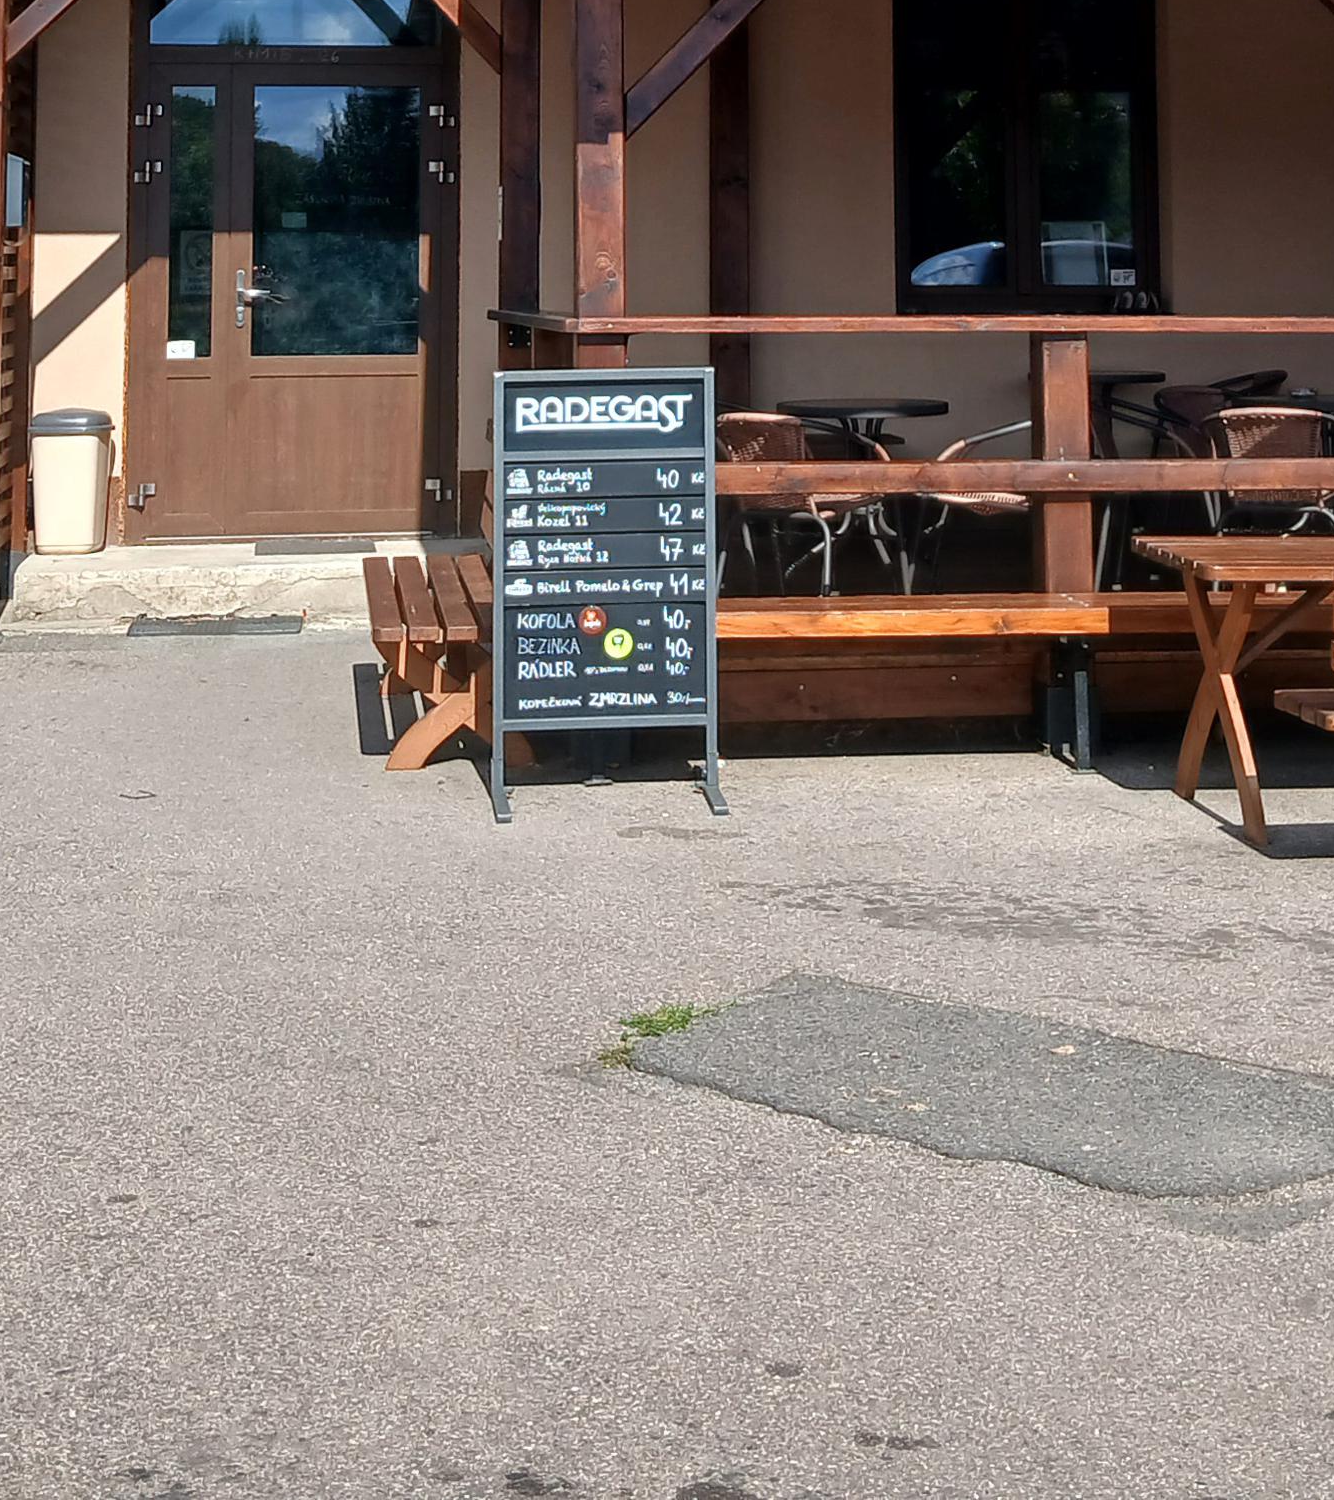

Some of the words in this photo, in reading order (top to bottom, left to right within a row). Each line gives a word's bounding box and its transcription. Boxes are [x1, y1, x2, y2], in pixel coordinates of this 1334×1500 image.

[515, 393, 693, 432] RADEGAST
[537, 467, 593, 485] Radegast
[656, 467, 680, 488] 40
[691, 471, 705, 483] Kč
[576, 481, 591, 492] 10
[537, 514, 571, 528] Kozel
[575, 515, 589, 527] 11
[658, 502, 683, 526] 42
[691, 507, 705, 520] Kč
[537, 537, 594, 556] Radegast
[659, 536, 685, 561] 47
[692, 543, 706, 556] Kč
[596, 550, 609, 563] 12
[537, 580, 571, 594] Birell
[575, 579, 621, 593] Pomelo
[622, 579, 631, 593] &
[632, 578, 664, 598] Grep
[669, 573, 689, 595] 41
[691, 578, 705, 591] Kč
[517, 612, 576, 629] KOFOLA
[517, 636, 582, 655] BEZINKA
[517, 659, 578, 680] RÁDLER
[518, 695, 583, 711] KOPEČKOVÁ
[588, 692, 658, 707] ZMRZLINA
